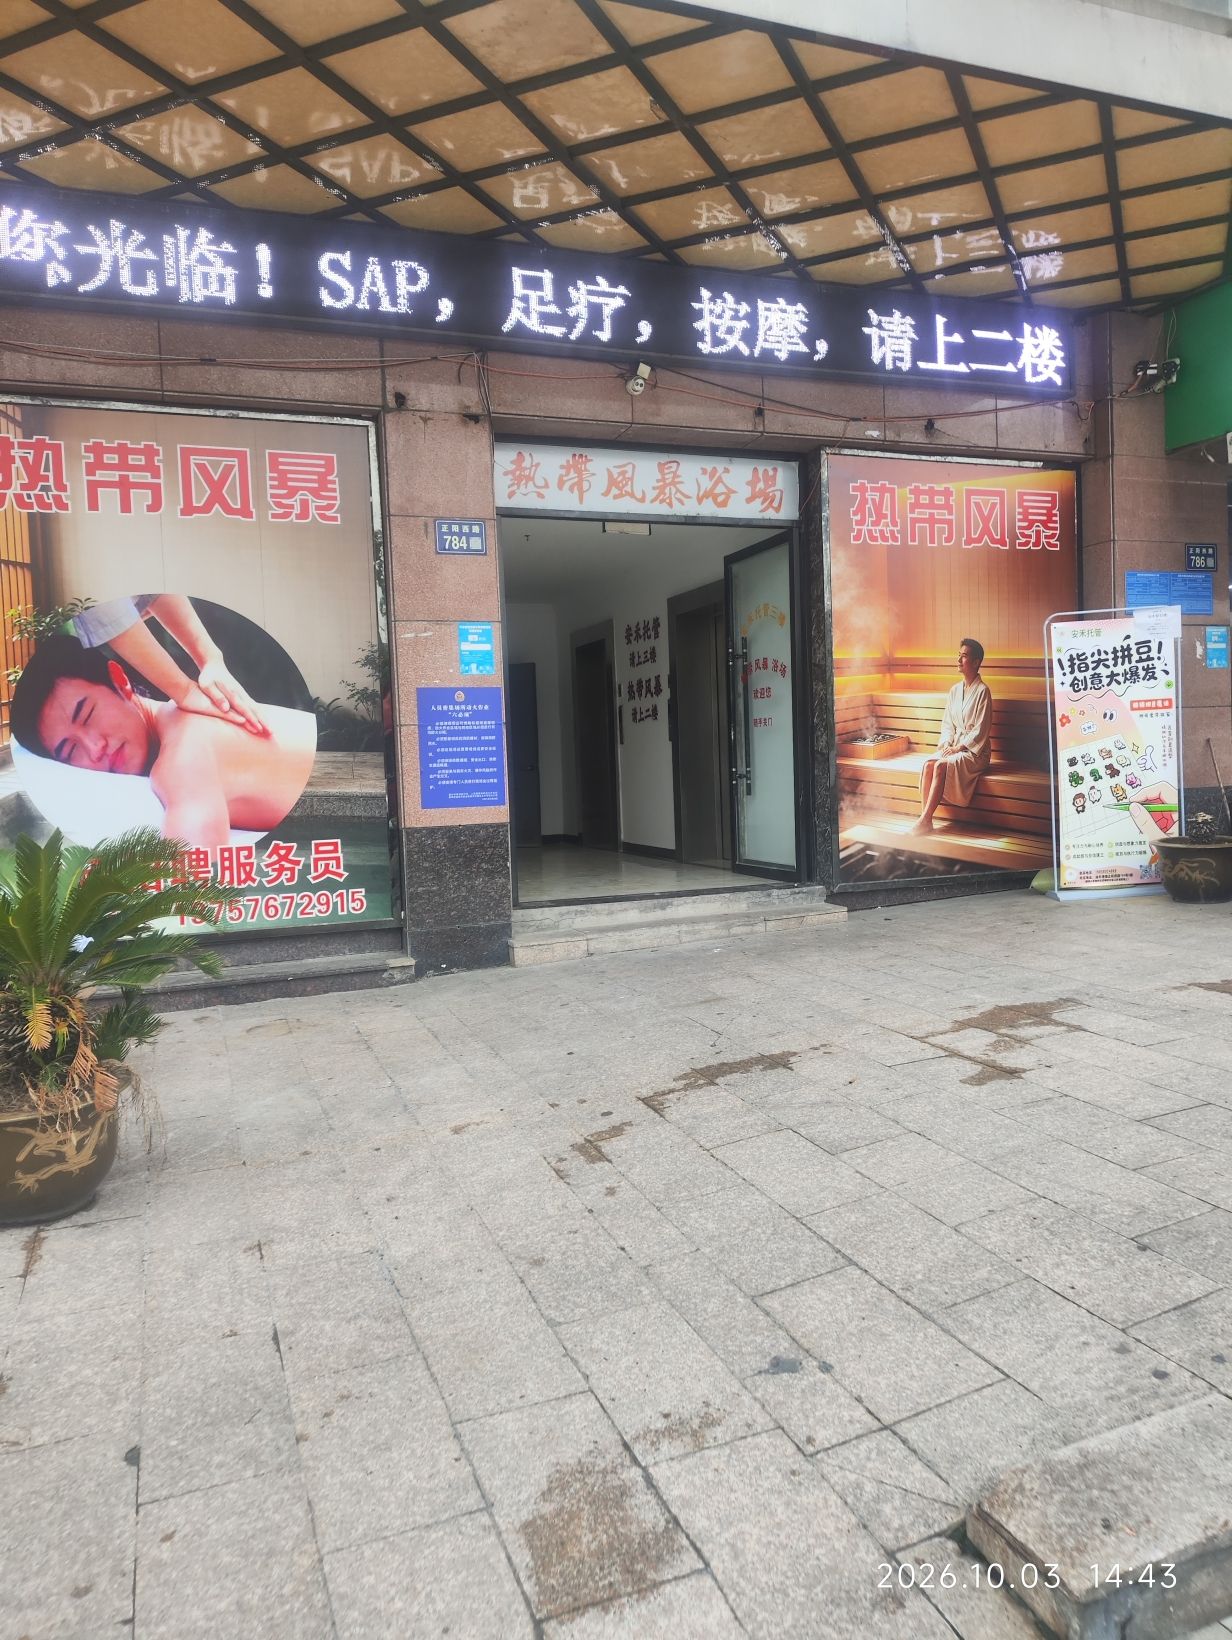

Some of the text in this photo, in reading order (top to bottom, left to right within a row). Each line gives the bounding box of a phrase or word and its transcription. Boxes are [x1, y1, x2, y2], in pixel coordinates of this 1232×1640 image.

[862, 306, 1067, 386] 请上二楼
[0, 434, 341, 525] 热带风暴
[850, 480, 1060, 550] 热带风暴
[443, 535, 468, 550] 784
[1190, 556, 1206, 568] 786
[624, 616, 661, 645] 安禾托管
[627, 674, 663, 702] 热带风暴
[1069, 664, 1158, 693] 创意大爆发
[135, 839, 348, 893] 聘服务员
